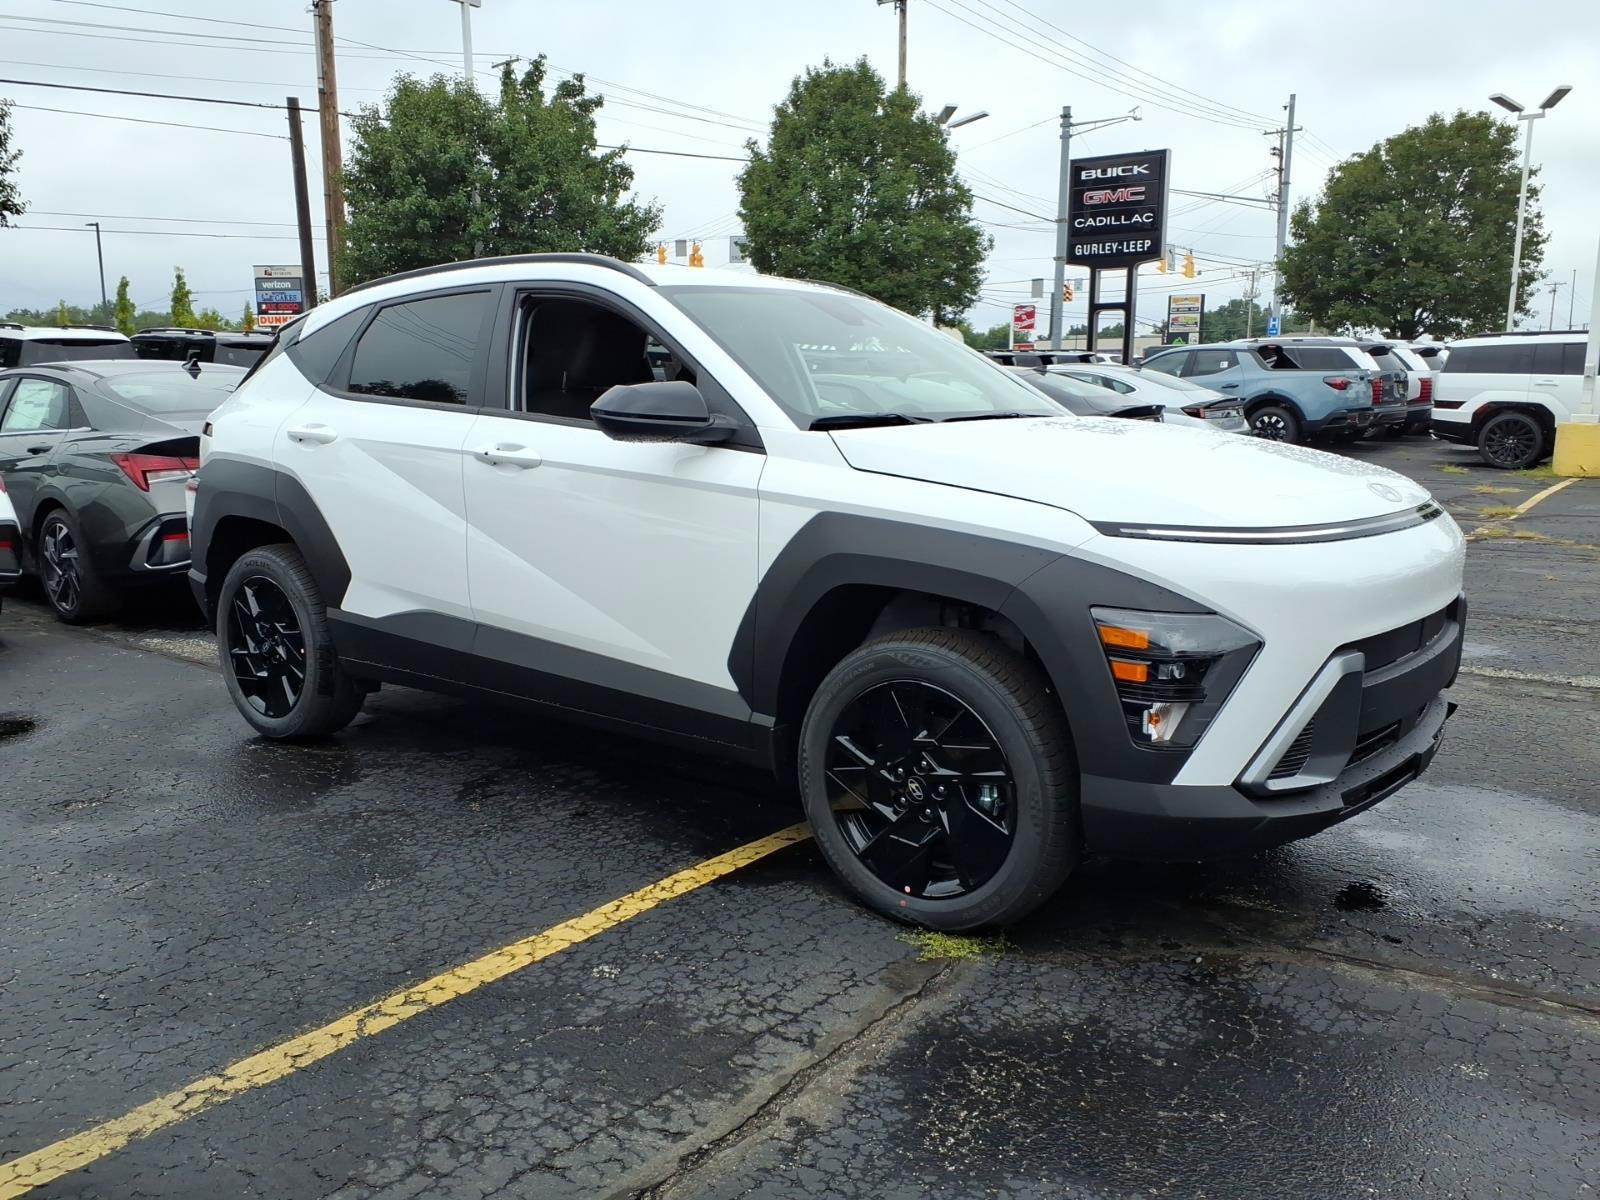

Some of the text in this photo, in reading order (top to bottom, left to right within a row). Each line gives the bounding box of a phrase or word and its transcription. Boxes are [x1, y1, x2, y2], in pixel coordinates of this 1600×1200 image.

[1081, 163, 1150, 180] BUICK
[1083, 186, 1145, 205] GMC
[1074, 213, 1154, 228] CADILLAC
[1075, 239, 1152, 256] GURLEY-LEEP
[262, 280, 291, 289] verizon
[260, 316, 294, 325] DUNK
[1270, 317, 1279, 329] H
